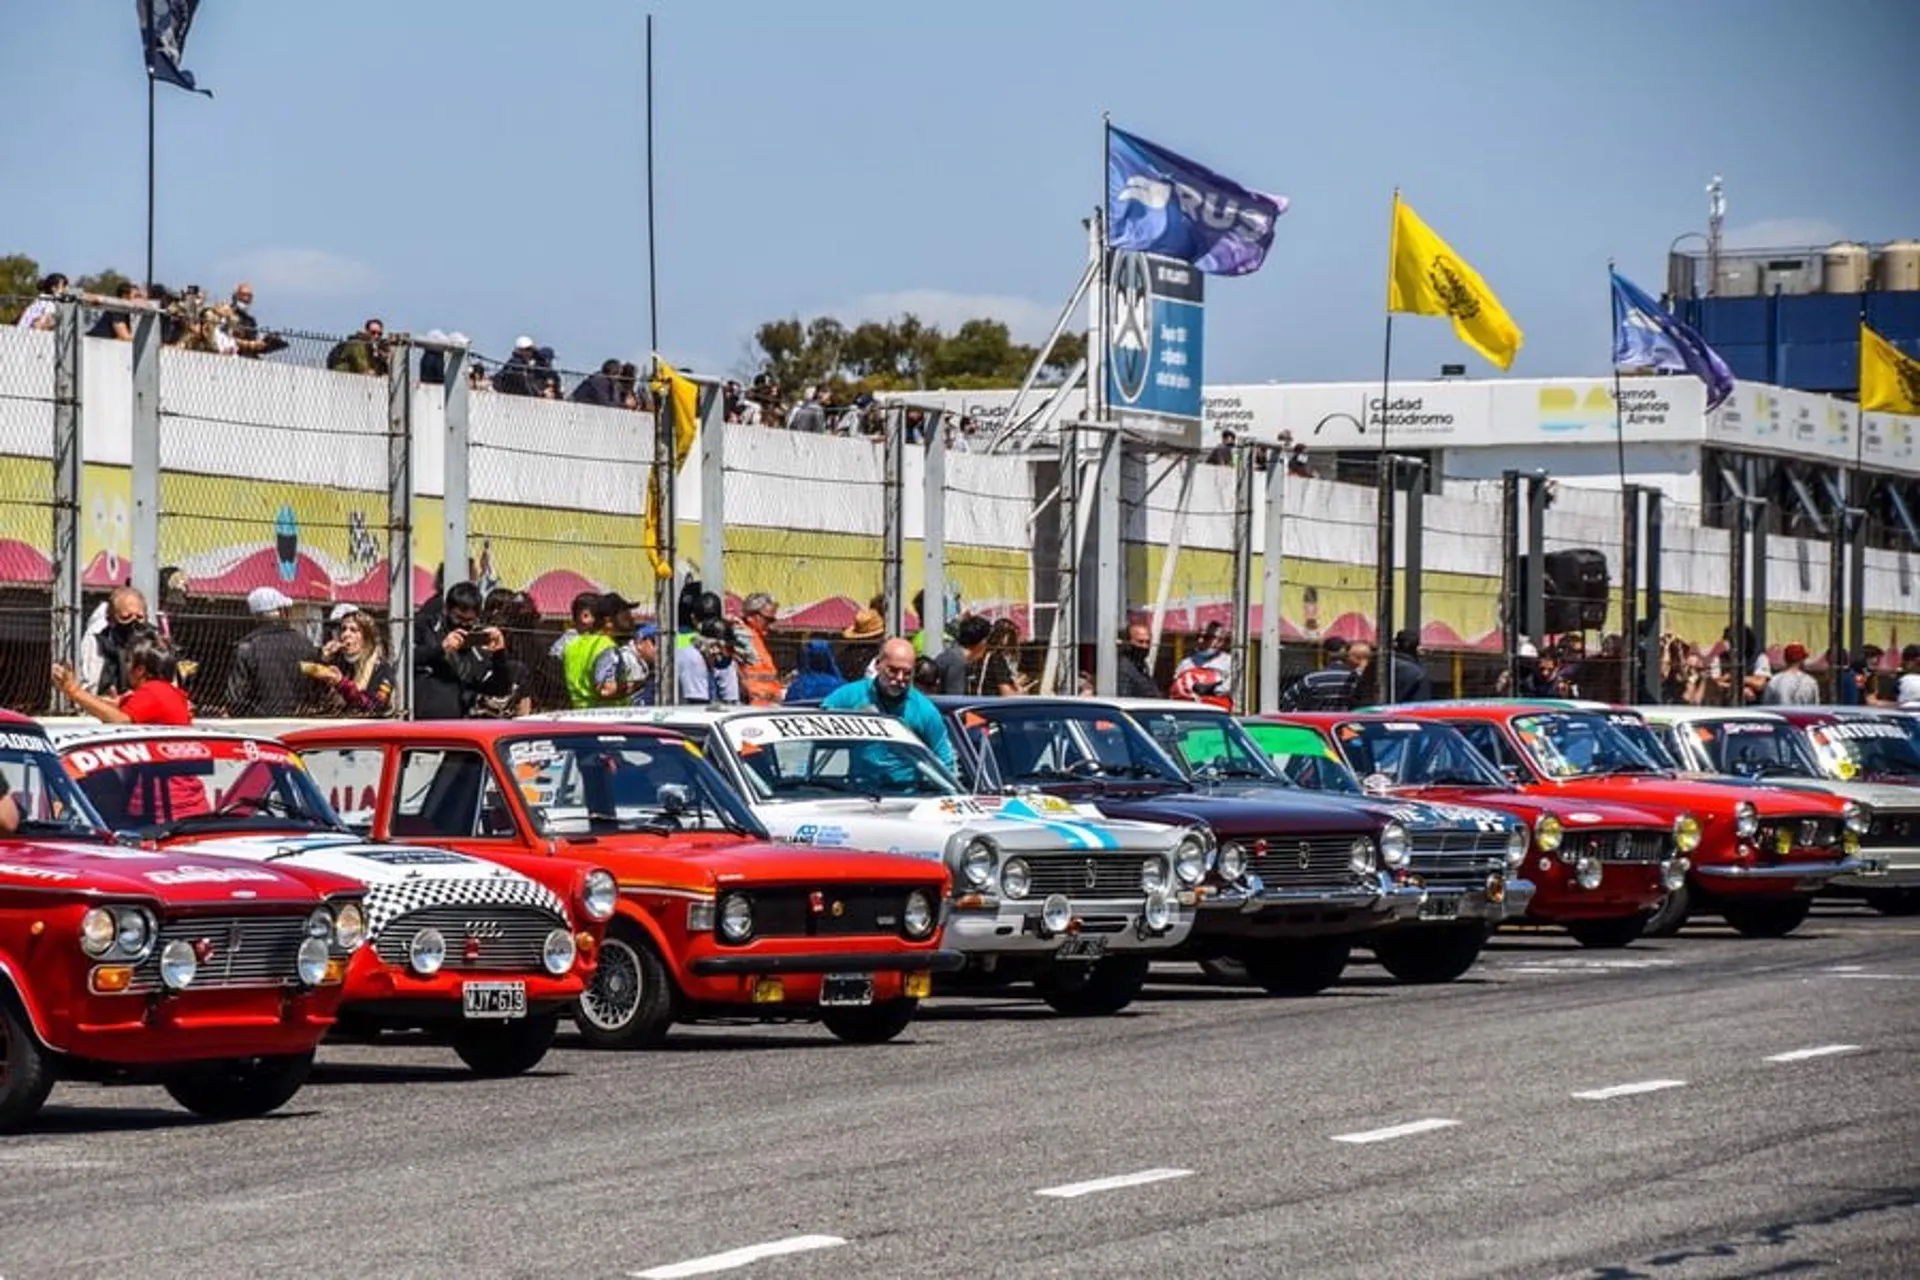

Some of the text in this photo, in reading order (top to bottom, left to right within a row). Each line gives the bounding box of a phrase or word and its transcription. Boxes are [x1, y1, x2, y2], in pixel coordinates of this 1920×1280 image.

[1370, 398, 1422, 411] Cudad
[769, 716, 894, 739] RENAULT
[70, 742, 152, 772] DKW
